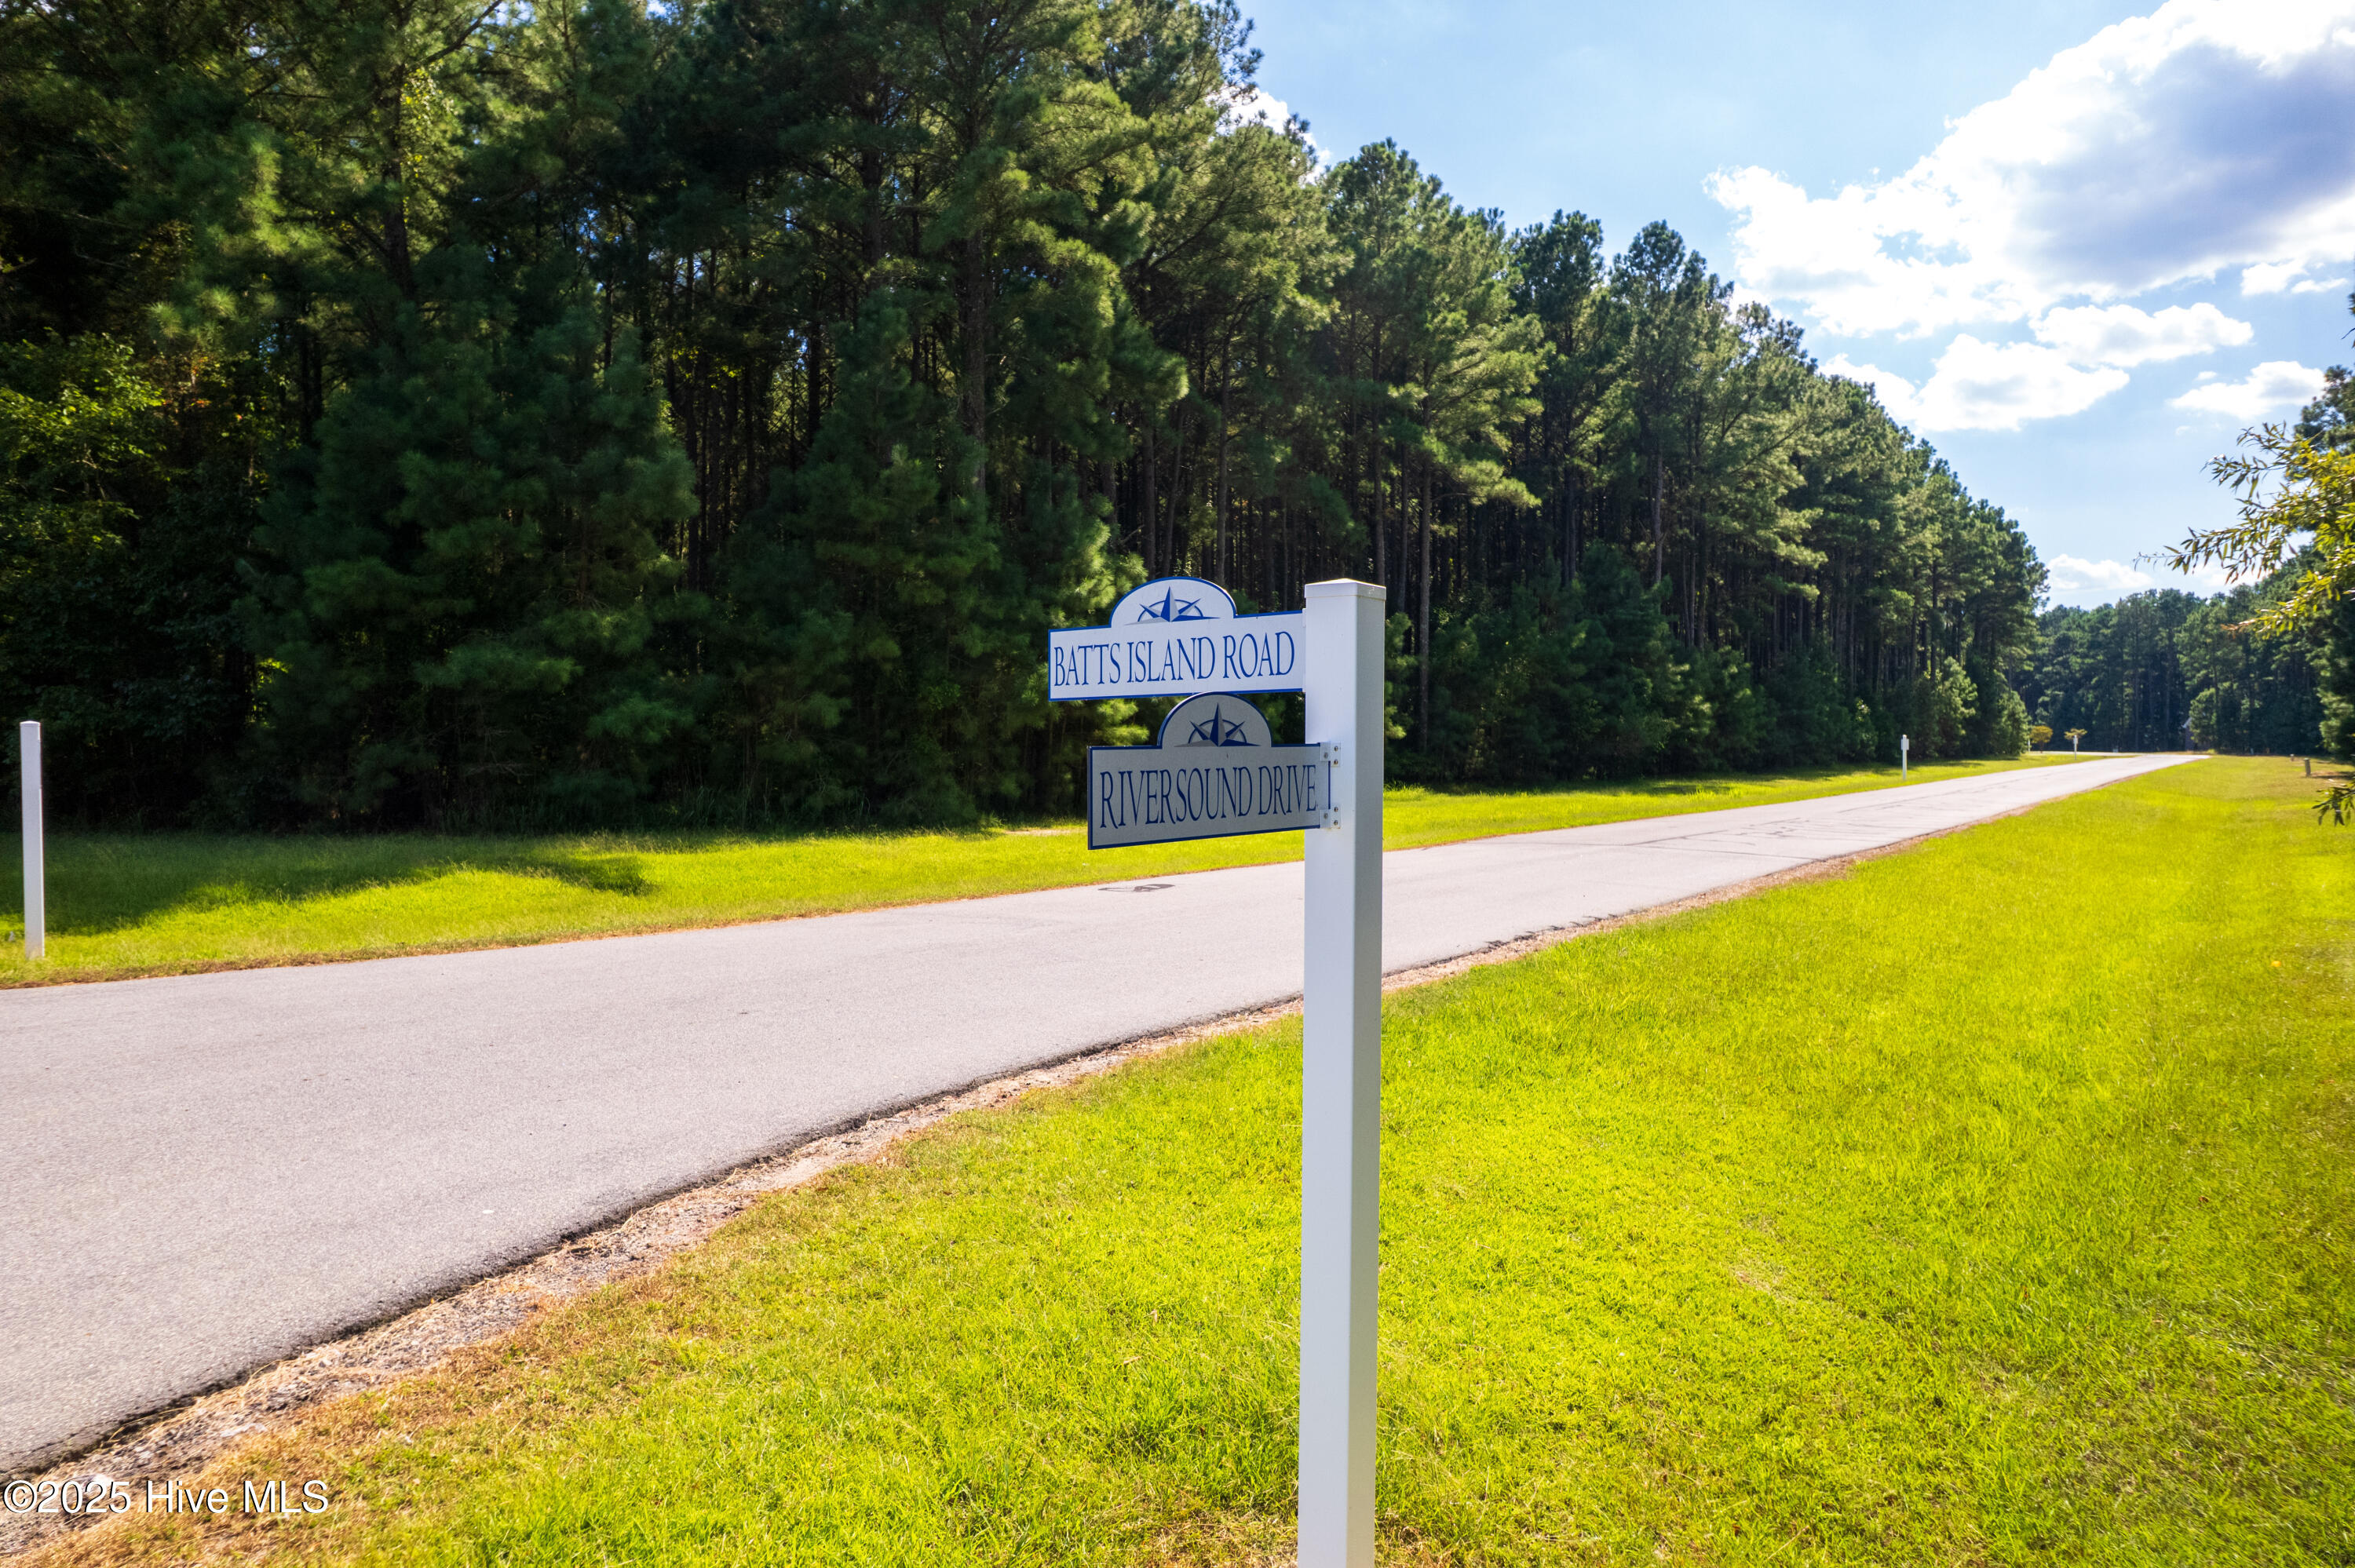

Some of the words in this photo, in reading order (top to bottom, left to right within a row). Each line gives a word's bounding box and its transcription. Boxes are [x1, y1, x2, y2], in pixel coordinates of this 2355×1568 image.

[1053, 643, 1121, 687] BATTS
[1126, 636, 1216, 684] ISLAND
[1223, 631, 1295, 680] ROAD
[1100, 766, 1253, 830] RIVERSOUND
[1258, 764, 1319, 815] DRIVE
